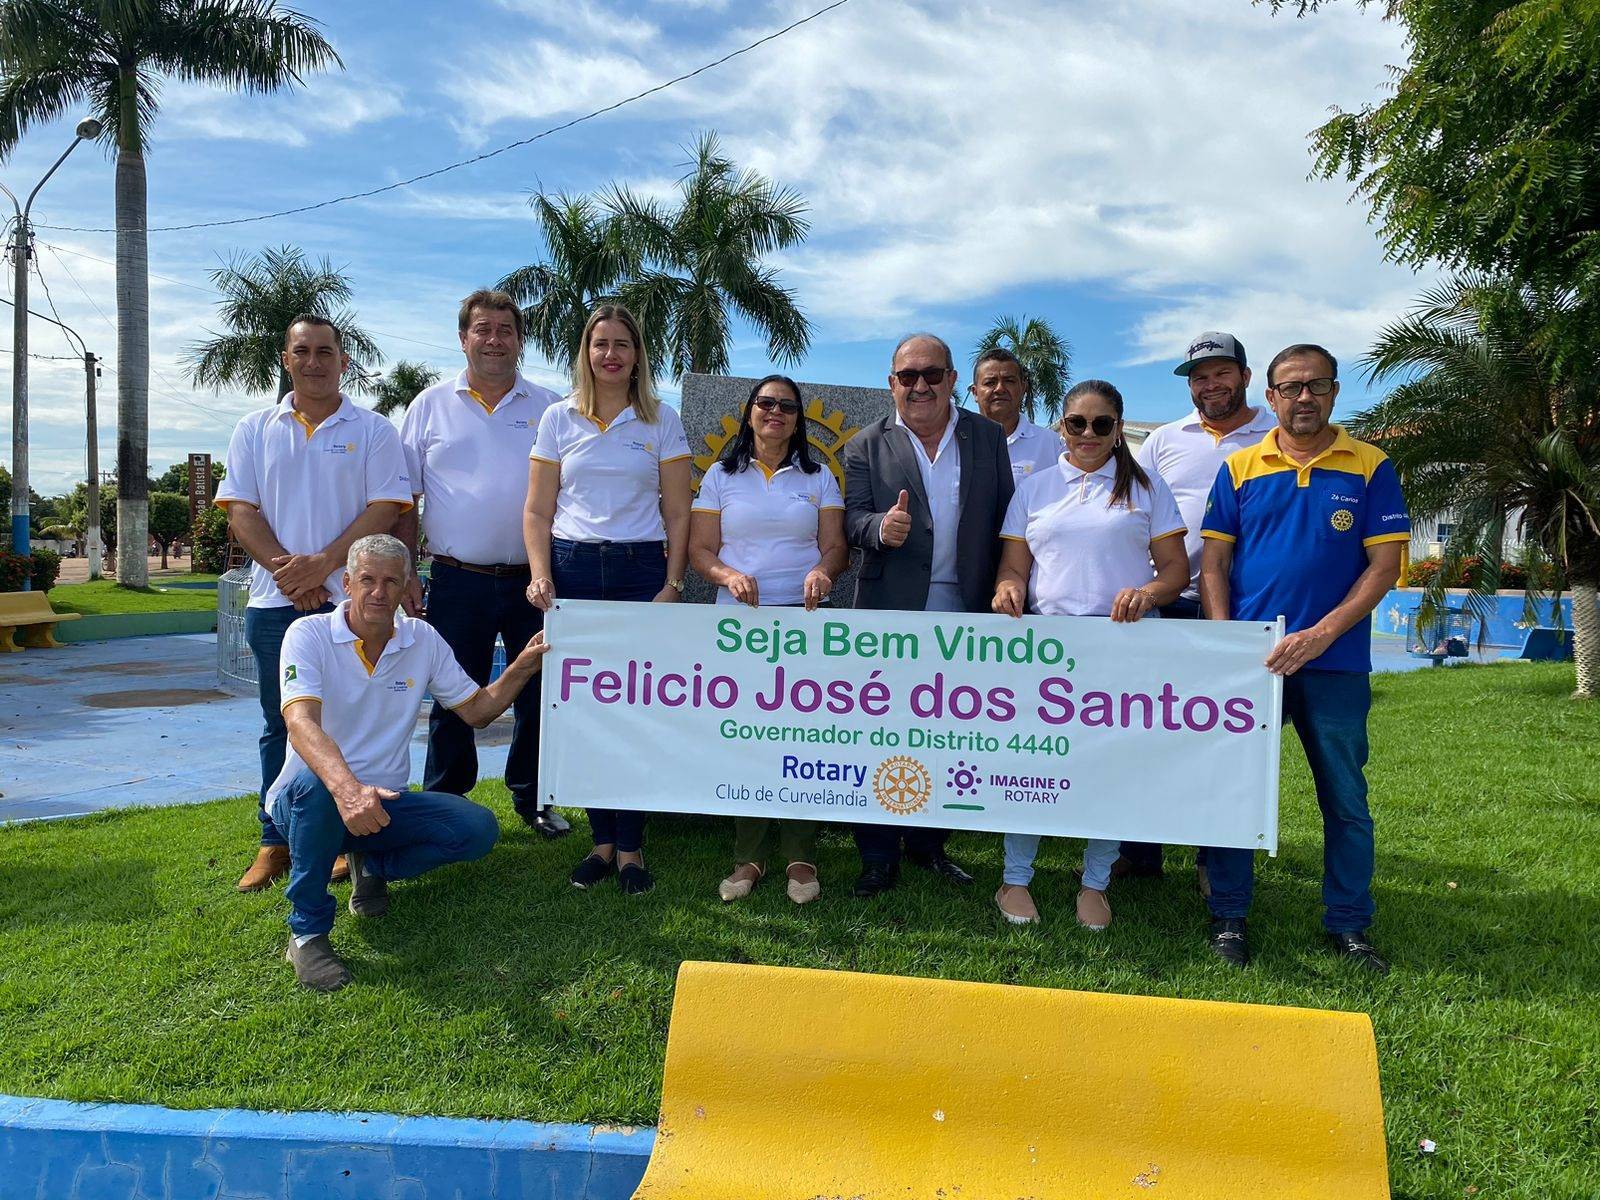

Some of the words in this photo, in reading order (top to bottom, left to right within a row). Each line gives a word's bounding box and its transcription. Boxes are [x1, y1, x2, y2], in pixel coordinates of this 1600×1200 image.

[195, 467, 206, 495] Batista
[195, 499, 206, 517] oão
[1340, 495, 1359, 504] Carlos
[716, 618, 807, 663] Seja
[822, 621, 919, 660] Bem
[934, 625, 1075, 672] Vindo,
[560, 658, 739, 709] Felicio
[755, 666, 891, 717] José
[910, 672, 1017, 722] dos
[1038, 677, 1254, 734] Santos
[719, 719, 862, 746] Governador
[869, 726, 900, 748] do
[908, 728, 1000, 753] Distrito
[1006, 733, 1070, 757] 4440
[782, 755, 868, 788] Rotary
[989, 774, 1056, 790] IMAGINE
[1059, 778, 1071, 790] O
[715, 783, 750, 801] Club
[755, 785, 774, 802] de
[778, 786, 868, 807] Curvelândia
[1004, 789, 1060, 804] ROTARY
